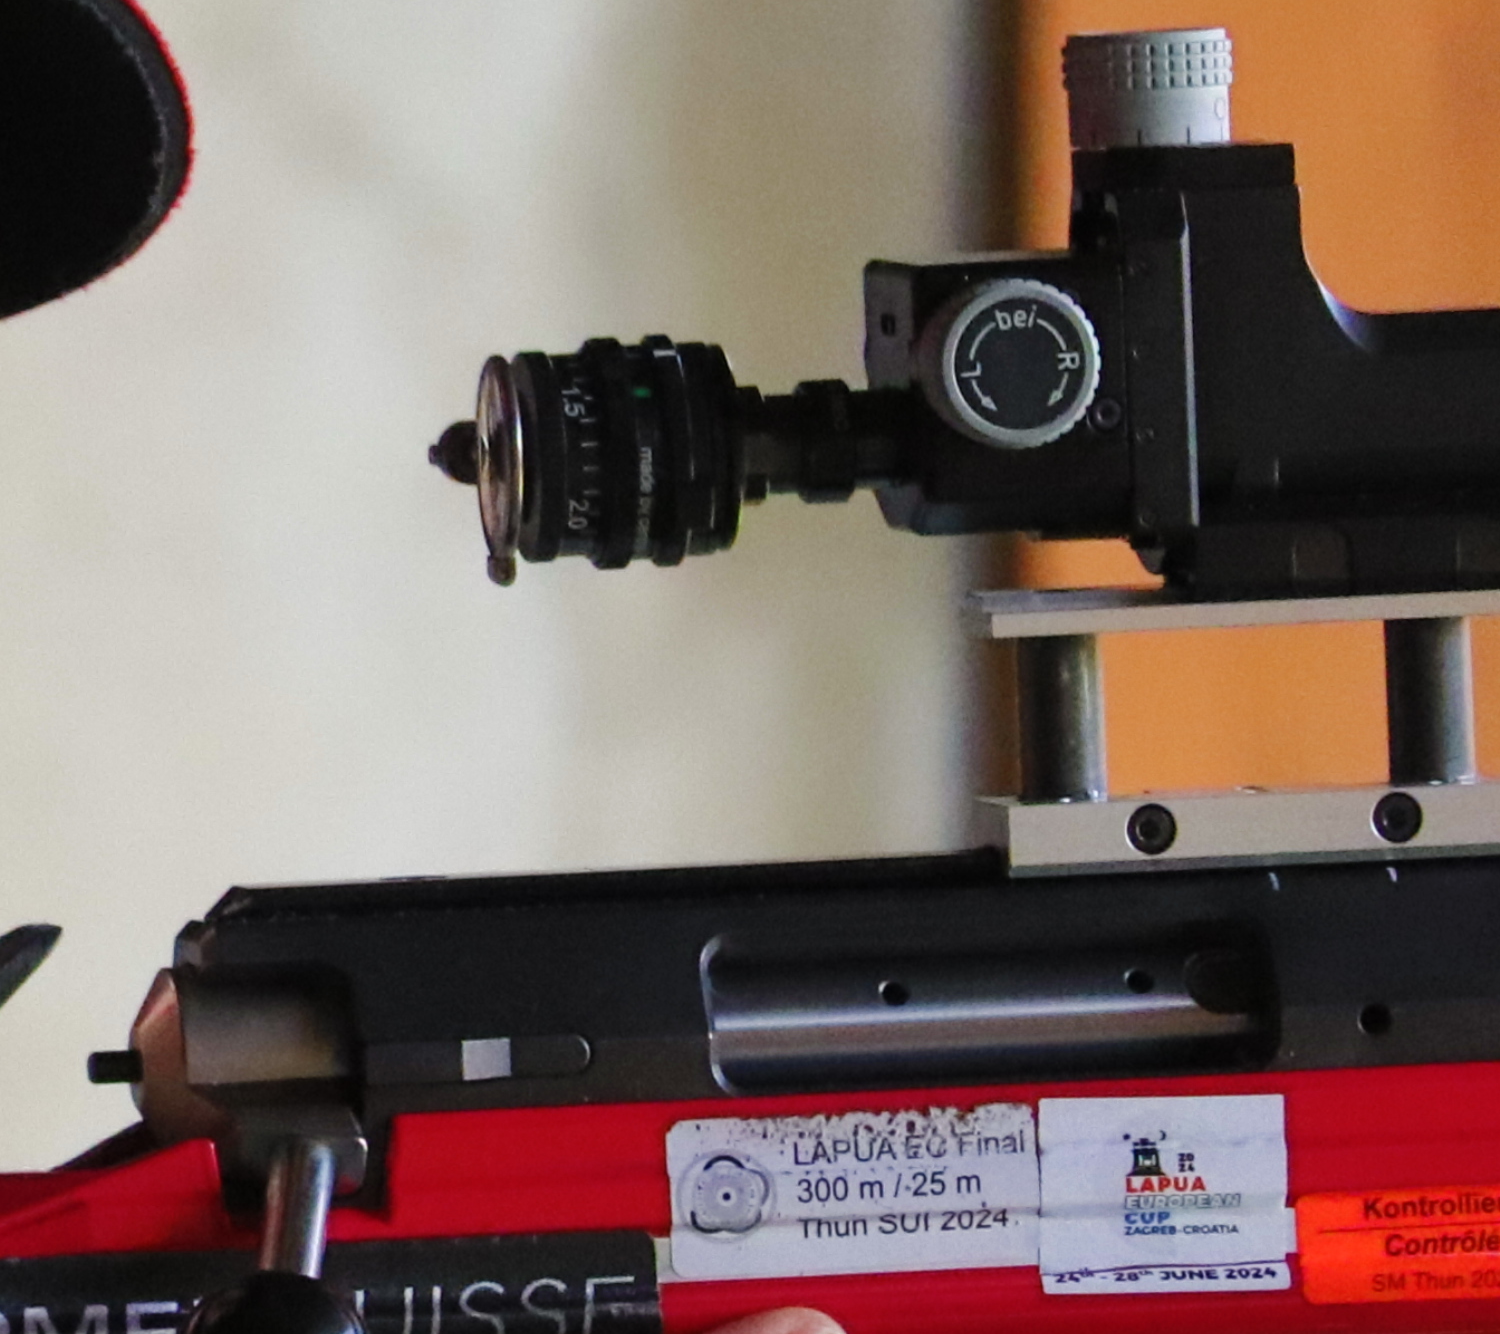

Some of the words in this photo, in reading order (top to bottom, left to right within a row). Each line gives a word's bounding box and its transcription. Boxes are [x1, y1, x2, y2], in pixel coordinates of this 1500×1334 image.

[994, 304, 1038, 331] bei
[960, 361, 982, 378] L
[1056, 352, 1080, 371] R
[793, 1137, 898, 1166] LAPUA
[957, 1129, 1026, 1157] Final
[1178, 1152, 1196, 1163] 20
[796, 1177, 849, 1204] 300
[859, 1180, 885, 1199] m
[911, 1170, 947, 1197] 25
[957, 1173, 982, 1194] m
[1125, 1175, 1207, 1194] LAPUA
[1123, 1193, 1242, 1211] EUROPEAN
[799, 1215, 868, 1240] Thun
[878, 1210, 931, 1236] SUI
[940, 1207, 1009, 1232] 2024
[1124, 1211, 1171, 1225] CUP
[1159, 1268, 1220, 1281] JUNE
[1224, 1266, 1278, 1280] 2024
[1371, 1273, 1406, 1293] SM
[1414, 1271, 1465, 1290] Thun
